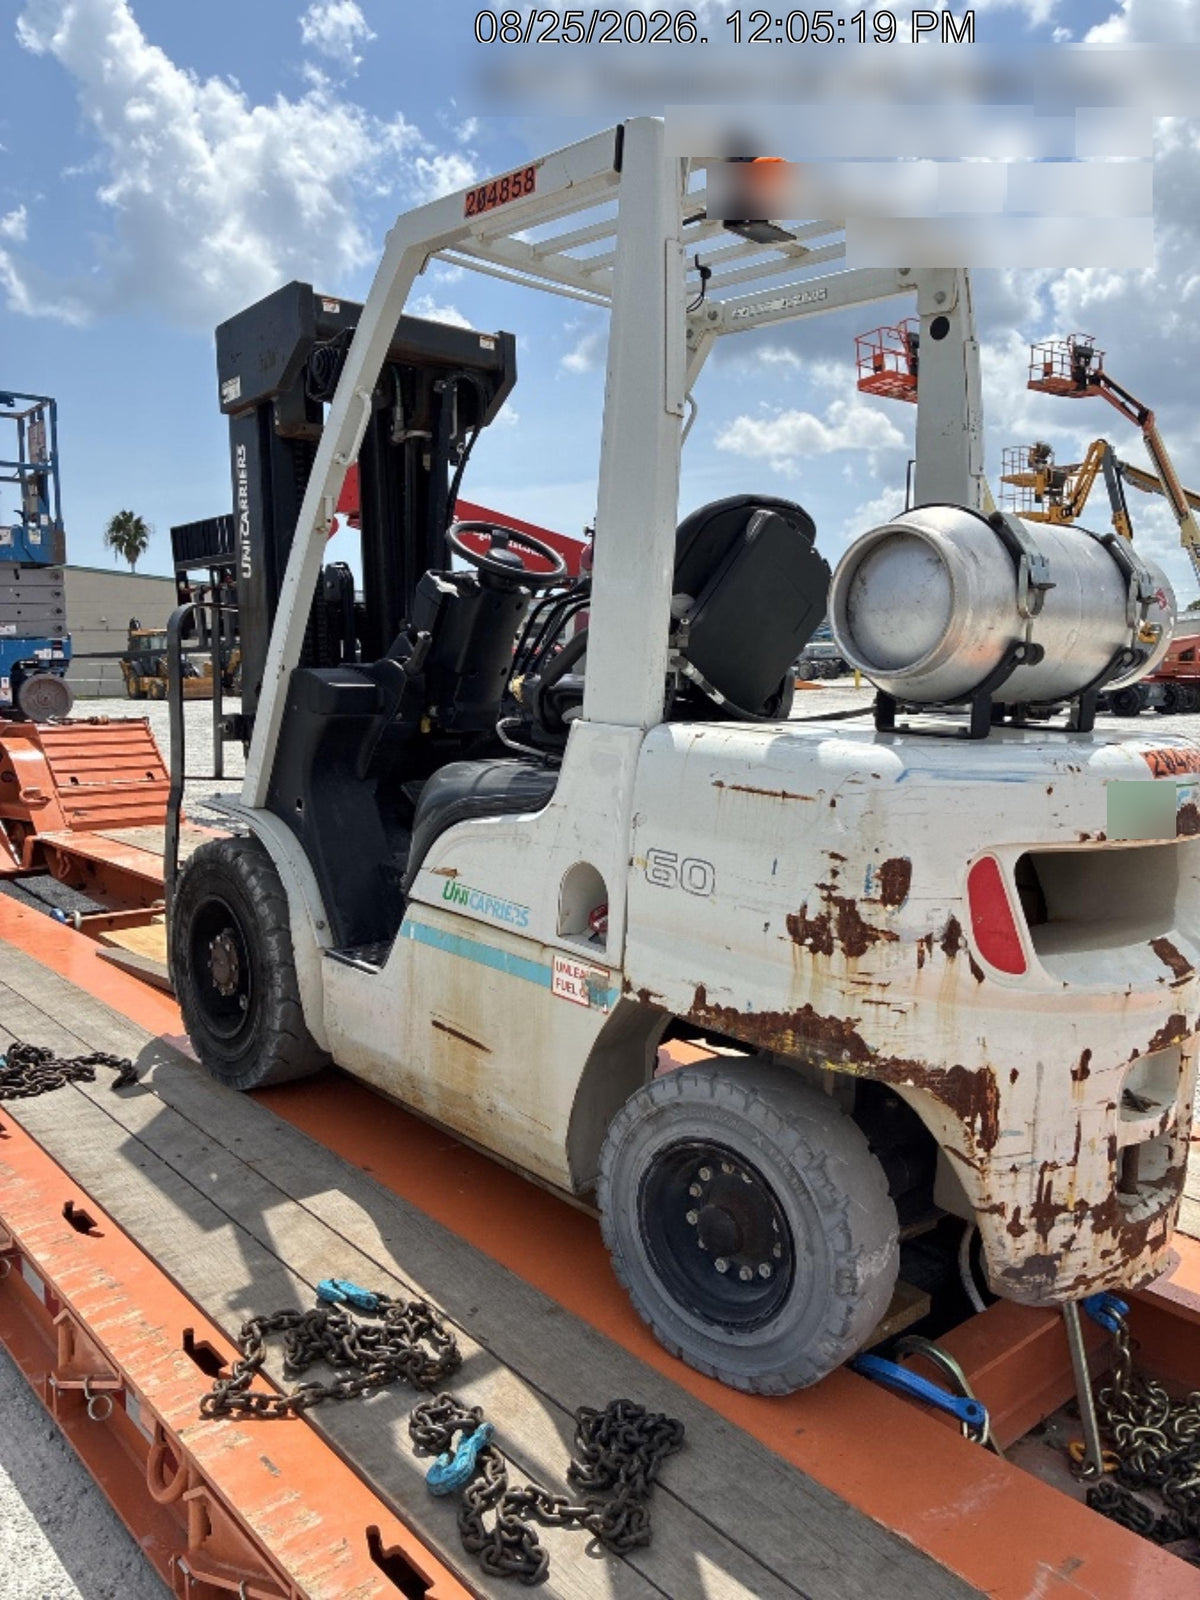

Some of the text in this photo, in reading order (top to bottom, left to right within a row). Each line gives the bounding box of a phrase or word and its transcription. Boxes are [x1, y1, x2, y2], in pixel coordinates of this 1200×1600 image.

[465, 166, 536, 218] 204858
[237, 444, 252, 578] UNICARRIERS
[645, 847, 715, 897] 60
[556, 977, 578, 995] FUEL
